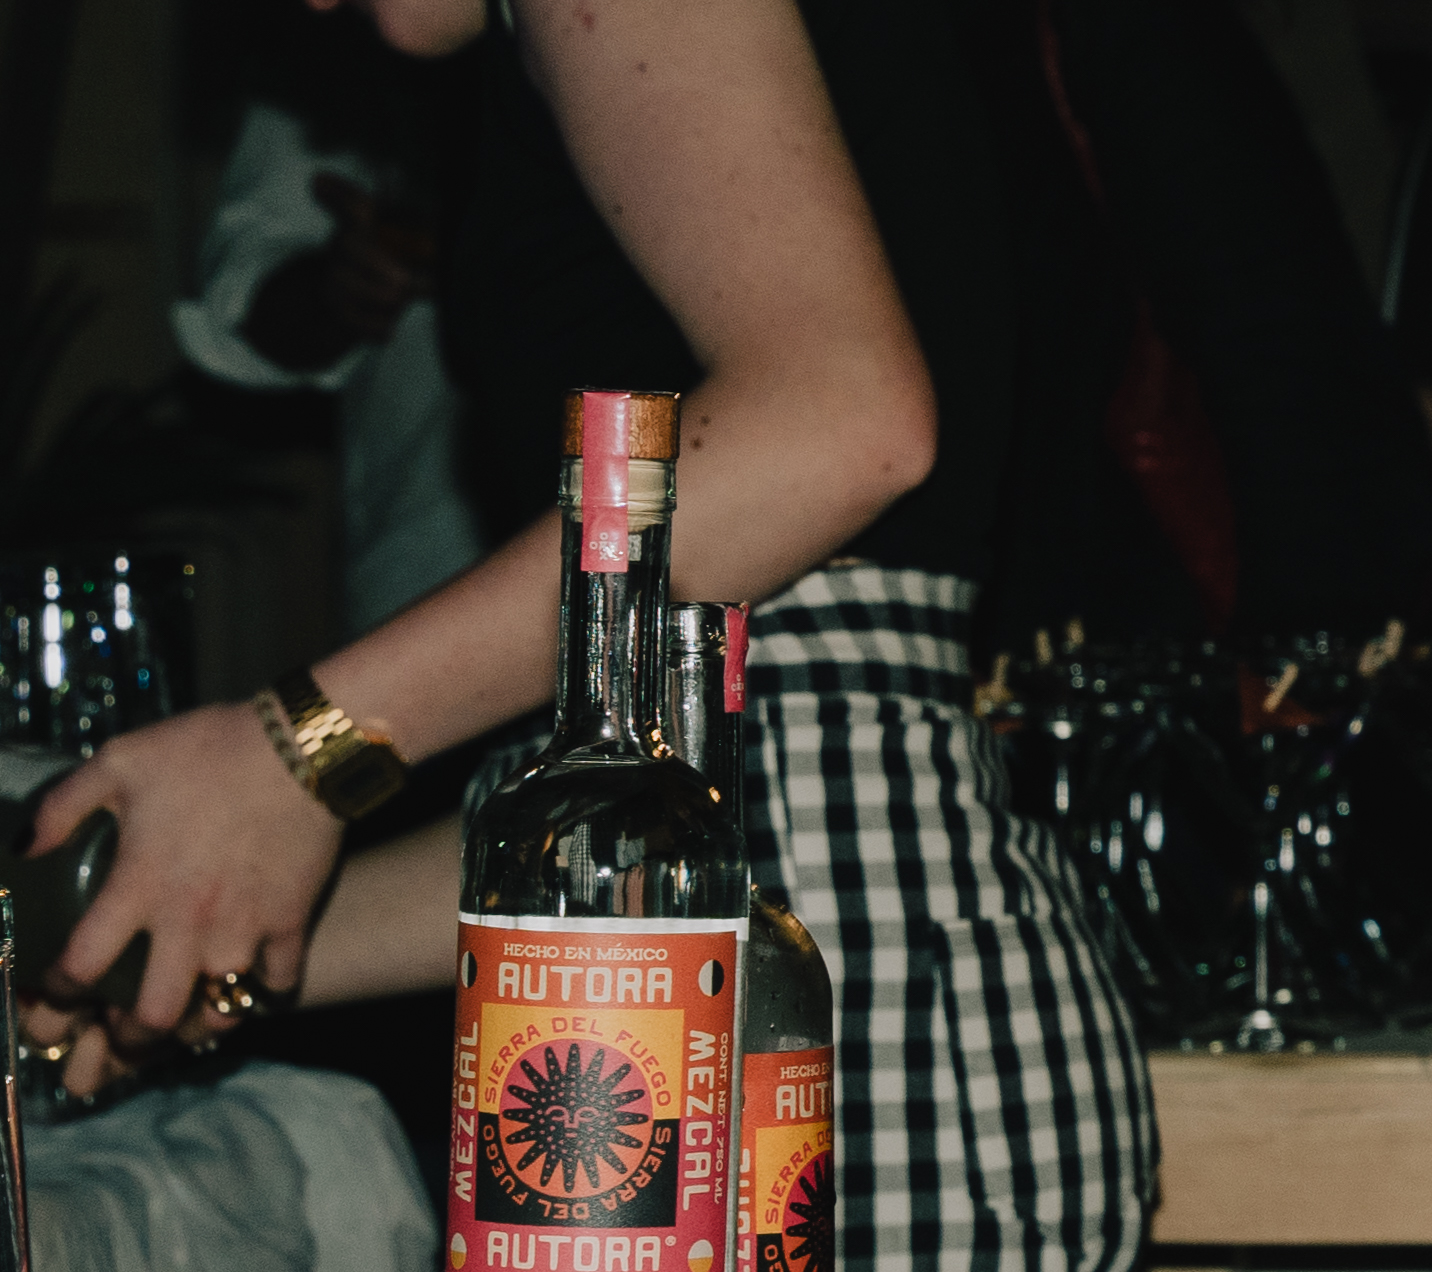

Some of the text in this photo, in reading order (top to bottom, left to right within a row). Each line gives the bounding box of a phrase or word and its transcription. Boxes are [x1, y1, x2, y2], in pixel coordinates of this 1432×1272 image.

[498, 962, 673, 1003] AUTORA
[503, 942, 668, 961] HECHO EN MÉXICO
[484, 1016, 672, 1107] SIERRA DEL FUEGO
[775, 1082, 833, 1121] AUT
[780, 1065, 820, 1080] HECHO
[455, 1021, 479, 1203] MEZCAL
[682, 1029, 717, 1211] MEZCAL
[483, 1125, 672, 1220] SIERRA DEL FUEGO
[765, 1141, 813, 1224] SIERRA
